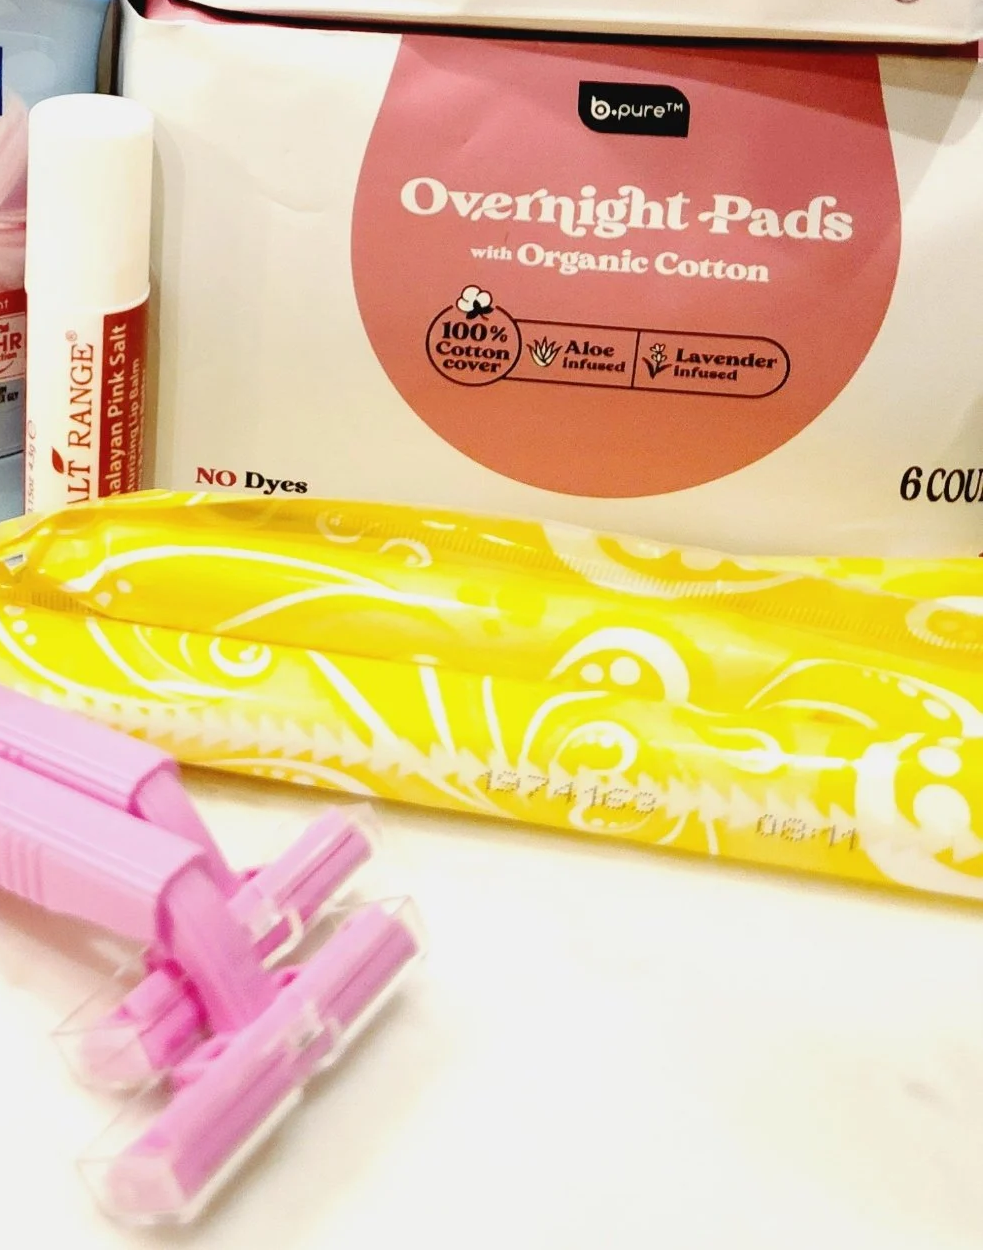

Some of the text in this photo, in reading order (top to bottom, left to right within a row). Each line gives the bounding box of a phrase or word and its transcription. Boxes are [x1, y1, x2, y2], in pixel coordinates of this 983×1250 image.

[400, 177, 854, 243] Overnight Pads
[470, 242, 770, 283] with Organic Cotton
[441, 318, 509, 343] 100%
[434, 340, 511, 363] Cotton
[564, 339, 615, 359] Aloe
[674, 349, 778, 371] Lavender
[441, 357, 503, 376] cover
[562, 355, 626, 375] infused
[672, 365, 738, 383] infused
[128, 358, 140, 398] Balm
[105, 323, 127, 494] alayan Pink Salt
[129, 402, 140, 425] Lip
[66, 461, 91, 505] LT
[195, 466, 309, 496] NO Dyes
[900, 466, 983, 503] 6 COU
